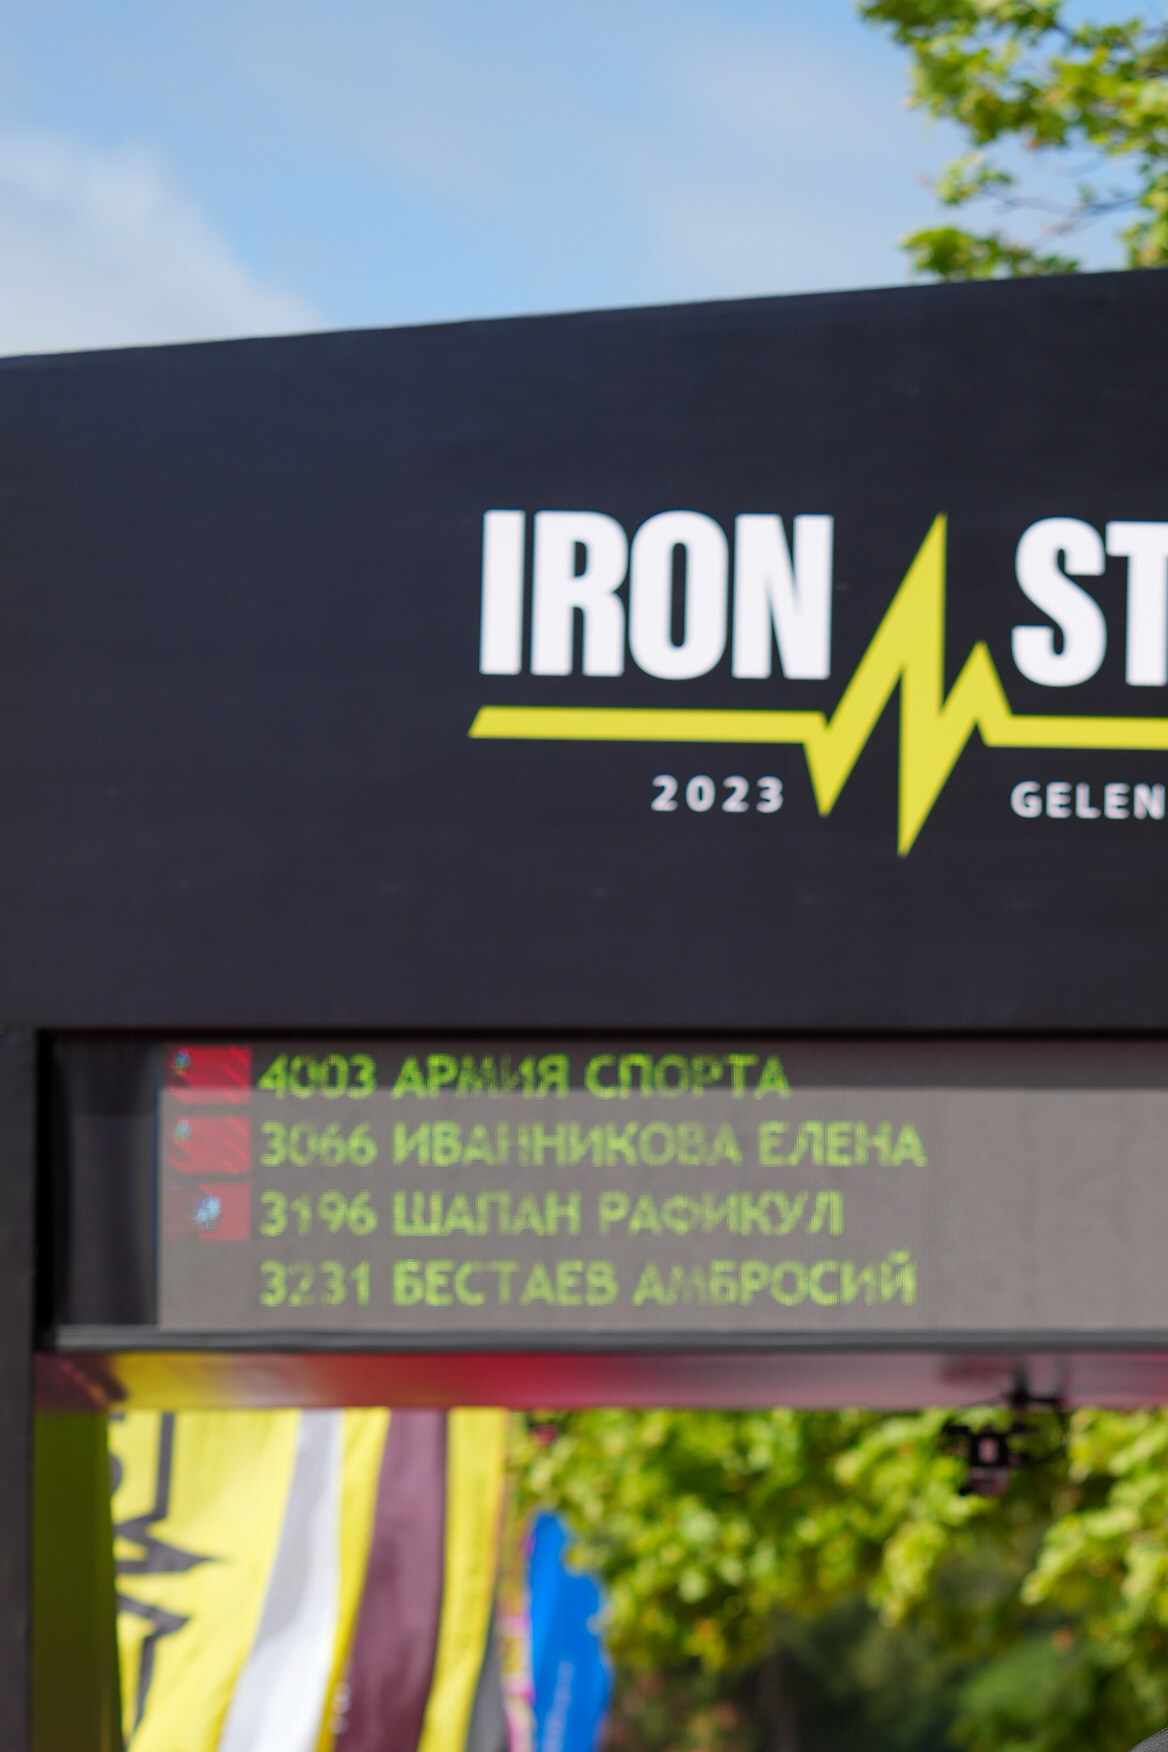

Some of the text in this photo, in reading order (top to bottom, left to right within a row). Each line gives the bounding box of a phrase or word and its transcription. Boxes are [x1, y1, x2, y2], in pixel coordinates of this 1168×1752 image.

[478, 509, 834, 681] IRON
[650, 774, 785, 814] 2023
[258, 1053, 377, 1099] 4003
[584, 1053, 791, 1099] СПОРТА
[260, 1120, 378, 1167] 3066
[758, 1120, 928, 1167] ЕЛЕНА
[260, 1189, 378, 1236] 3196
[393, 1190, 581, 1236] ШАПАН
[259, 1259, 371, 1306] 3231
[393, 1259, 619, 1306] БЕСТАЕВ
